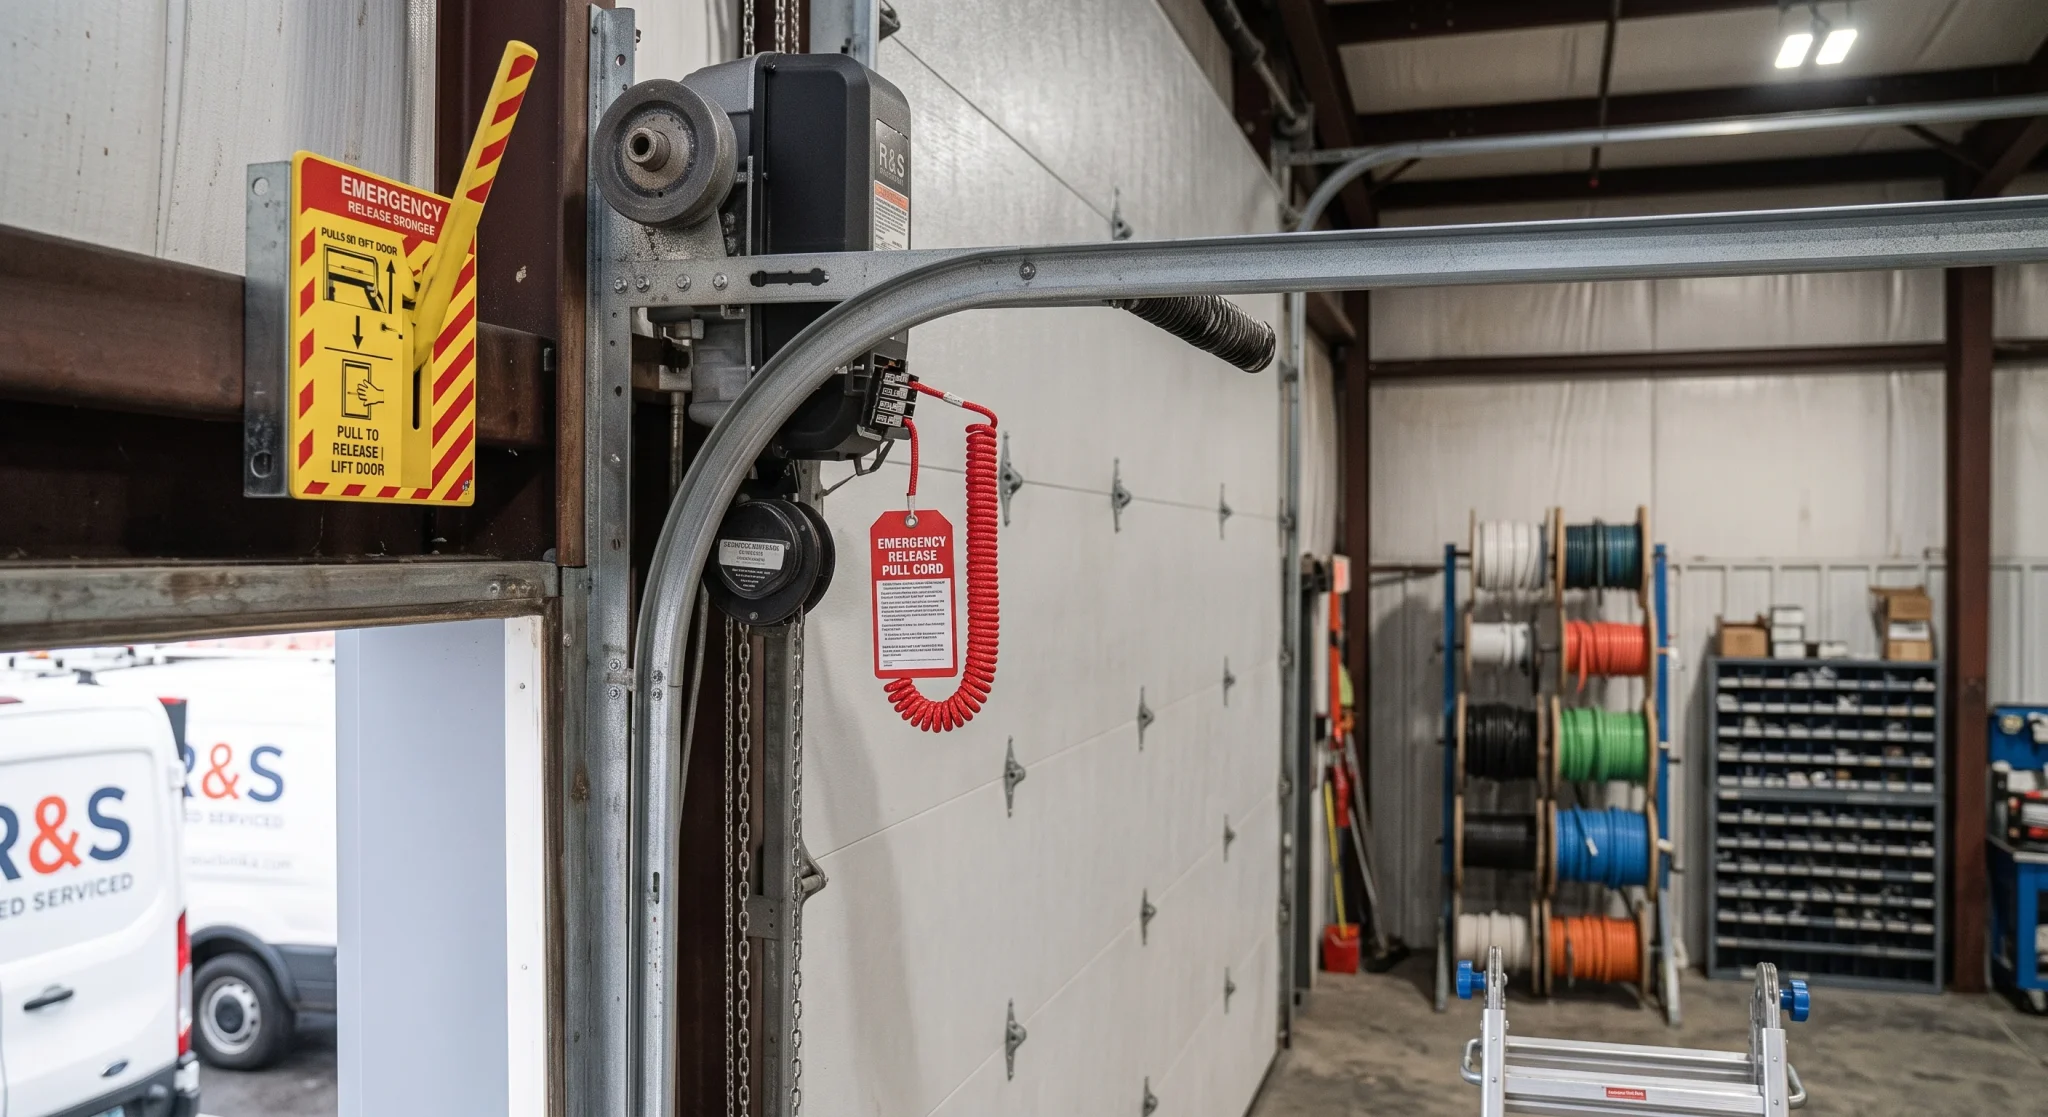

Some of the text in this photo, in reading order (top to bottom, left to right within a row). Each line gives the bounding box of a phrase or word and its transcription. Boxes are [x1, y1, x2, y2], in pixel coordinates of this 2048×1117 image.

[879, 141, 905, 178] R&S
[341, 174, 442, 222] EMERGENCY
[348, 200, 435, 236] RELEASE SRONGEE
[321, 227, 345, 242] PULLS
[376, 242, 398, 256] DOOR
[337, 425, 379, 441] PULL TO
[332, 442, 379, 459] RELEASE
[331, 460, 385, 476] LIFT DOOR
[877, 536, 947, 549] EMERGENCY
[888, 550, 937, 563] RELEASE
[882, 563, 944, 576] PULL CORD
[33, 871, 134, 911] SERVICED
